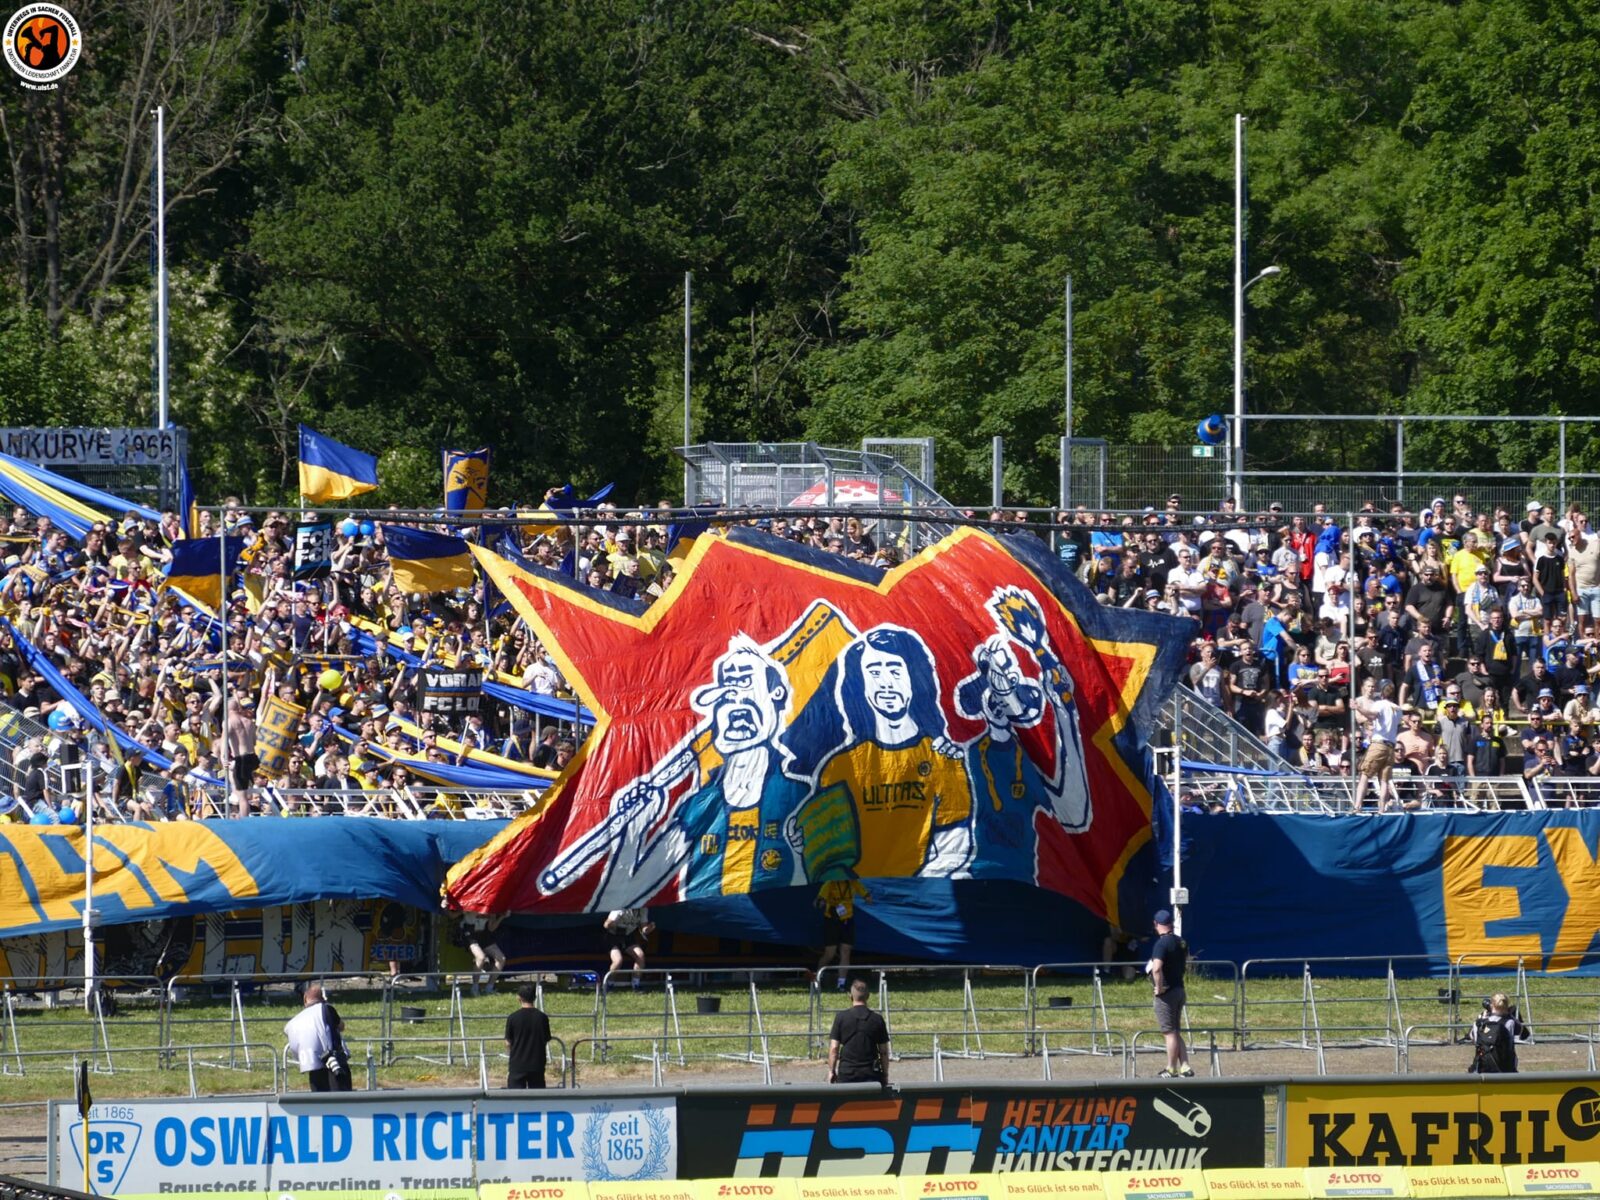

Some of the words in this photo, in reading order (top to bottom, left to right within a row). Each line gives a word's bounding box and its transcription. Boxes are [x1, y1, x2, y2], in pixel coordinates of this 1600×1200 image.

[0, 431, 112, 460] NKURVE
[104, 1106, 134, 1121] 1865
[1002, 1097, 1137, 1128] HEIZUNG
[610, 1114, 640, 1137] seit
[154, 1113, 352, 1167] OSWALD
[372, 1110, 575, 1162] RICHTER
[996, 1116, 1131, 1156] SANITÄR
[1308, 1109, 1566, 1168] KAFRIL
[607, 1138, 644, 1162] 1865
[992, 1147, 1208, 1174] HAUSTECHNIK
[1344, 1174, 1382, 1183] LOTTO
[1541, 1169, 1580, 1179] LOTTO
[939, 1181, 978, 1192] LOTTO
[1143, 1177, 1182, 1188] LOTTO
[1210, 1181, 1227, 1189] Das
[1229, 1180, 1255, 1189] Glück
[1257, 1180, 1268, 1188] ist
[1271, 1181, 1282, 1189] so
[1411, 1178, 1428, 1186] Das
[1430, 1177, 1456, 1186] Glück
[1458, 1176, 1469, 1185] ist
[1471, 1177, 1482, 1185] so
[523, 1189, 564, 1199] LOTTO
[734, 1185, 774, 1195] LOTTO
[802, 1189, 820, 1197] Das
[822, 1188, 848, 1197] Glück
[850, 1187, 861, 1196] ist
[1008, 1185, 1025, 1193] Das
[1027, 1184, 1053, 1193] Glück
[1055, 1184, 1066, 1192] ist
[1069, 1184, 1080, 1192] so
